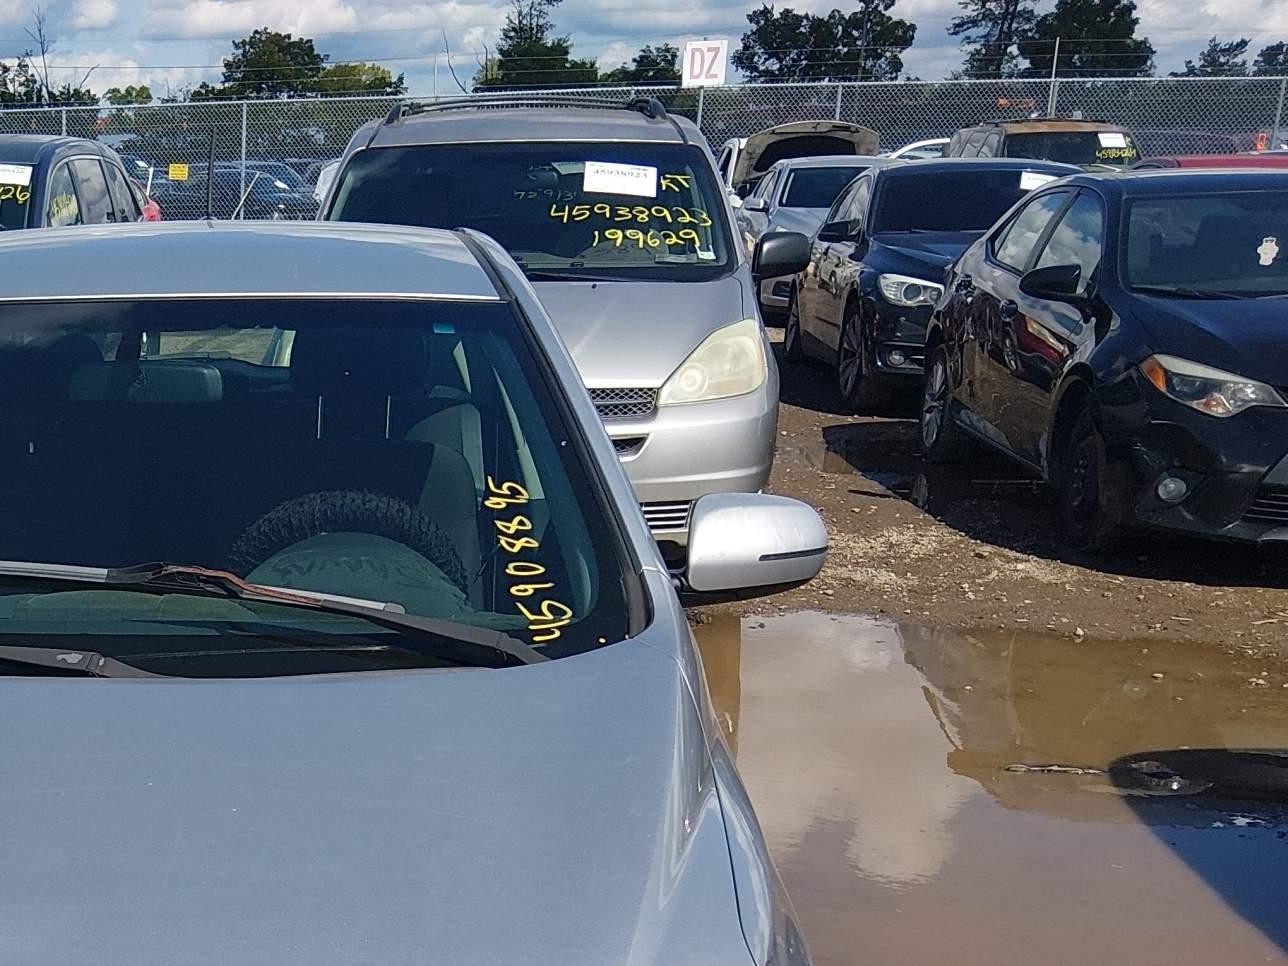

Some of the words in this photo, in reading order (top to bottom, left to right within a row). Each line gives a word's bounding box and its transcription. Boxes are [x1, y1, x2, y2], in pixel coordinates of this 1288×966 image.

[689, 46, 721, 80] DZ
[660, 174, 692, 192] KT
[550, 203, 713, 227] 45938923
[592, 228, 702, 249] 199629
[483, 475, 573, 643] 45908895
